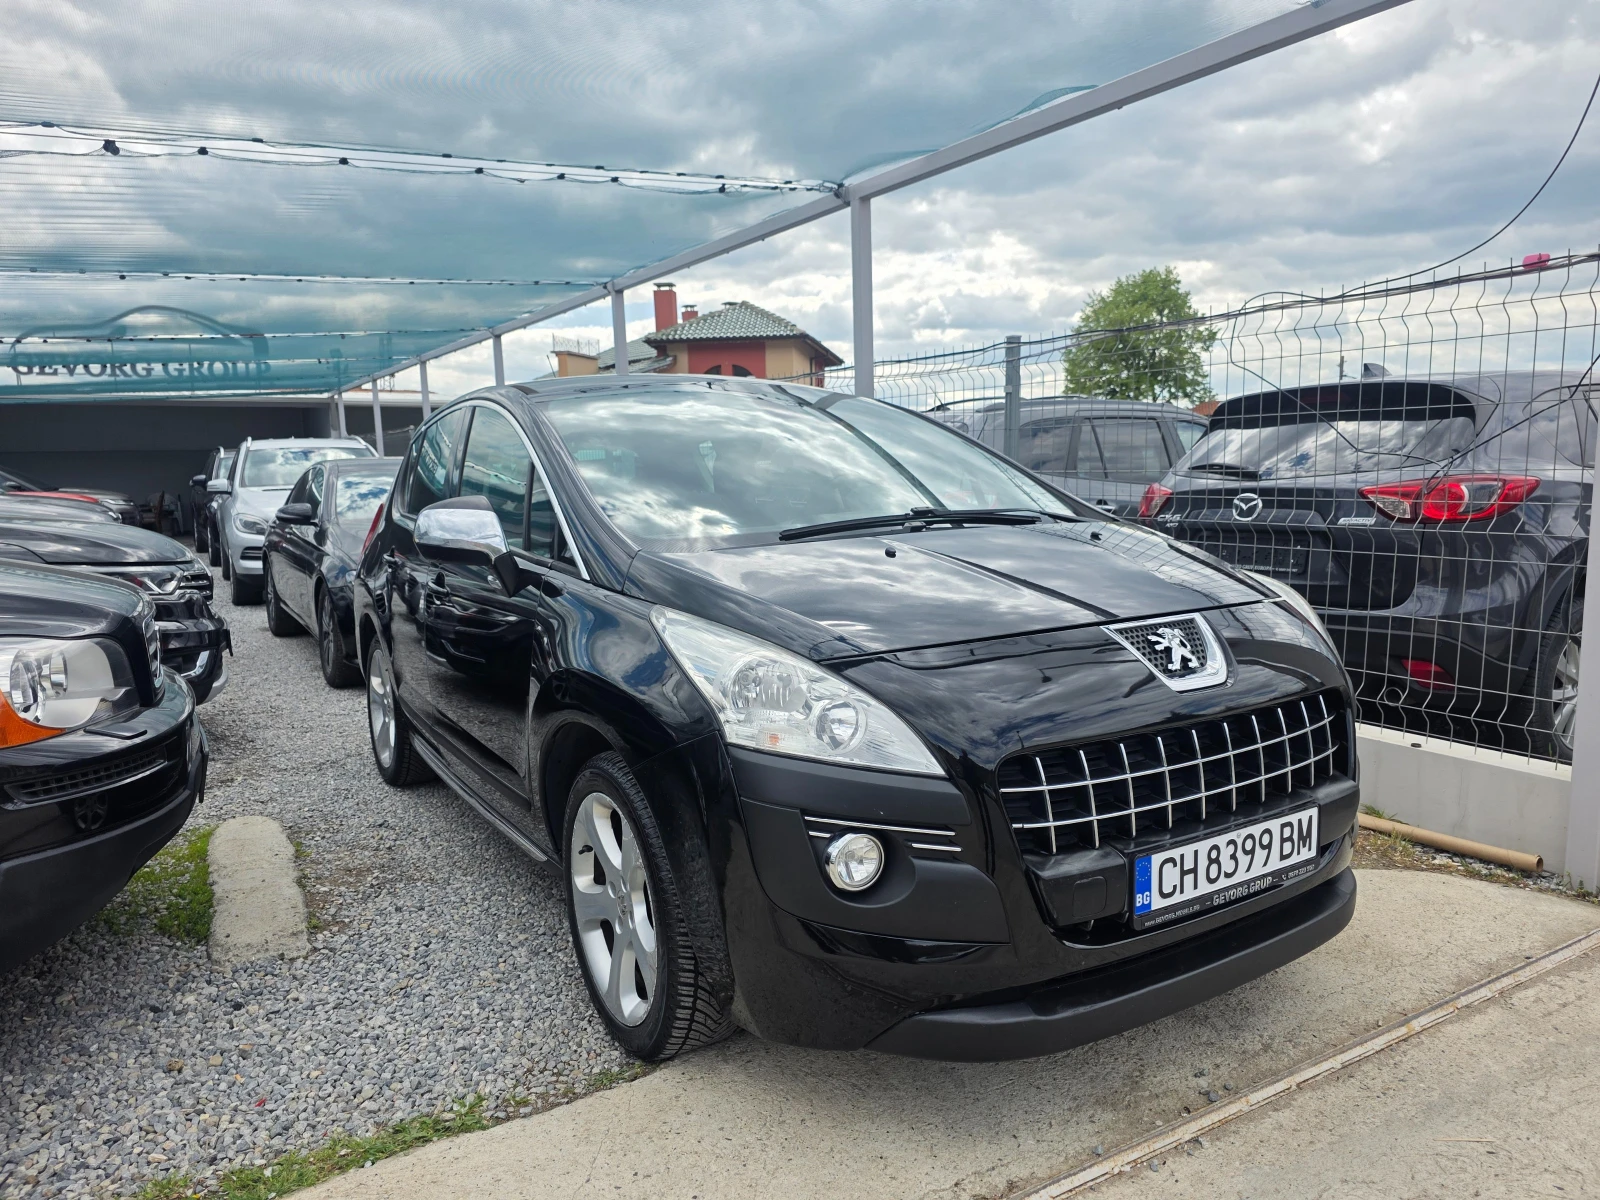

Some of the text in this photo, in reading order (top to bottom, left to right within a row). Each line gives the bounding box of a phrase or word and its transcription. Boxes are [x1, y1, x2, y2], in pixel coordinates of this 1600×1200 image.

[10, 355, 272, 379] GEVORG GROUP
[1158, 814, 1313, 899] CH 8399 BM
[1135, 891, 1151, 907] BG
[1213, 884, 1248, 906] GEVORG
[1250, 876, 1273, 893] GRUP
